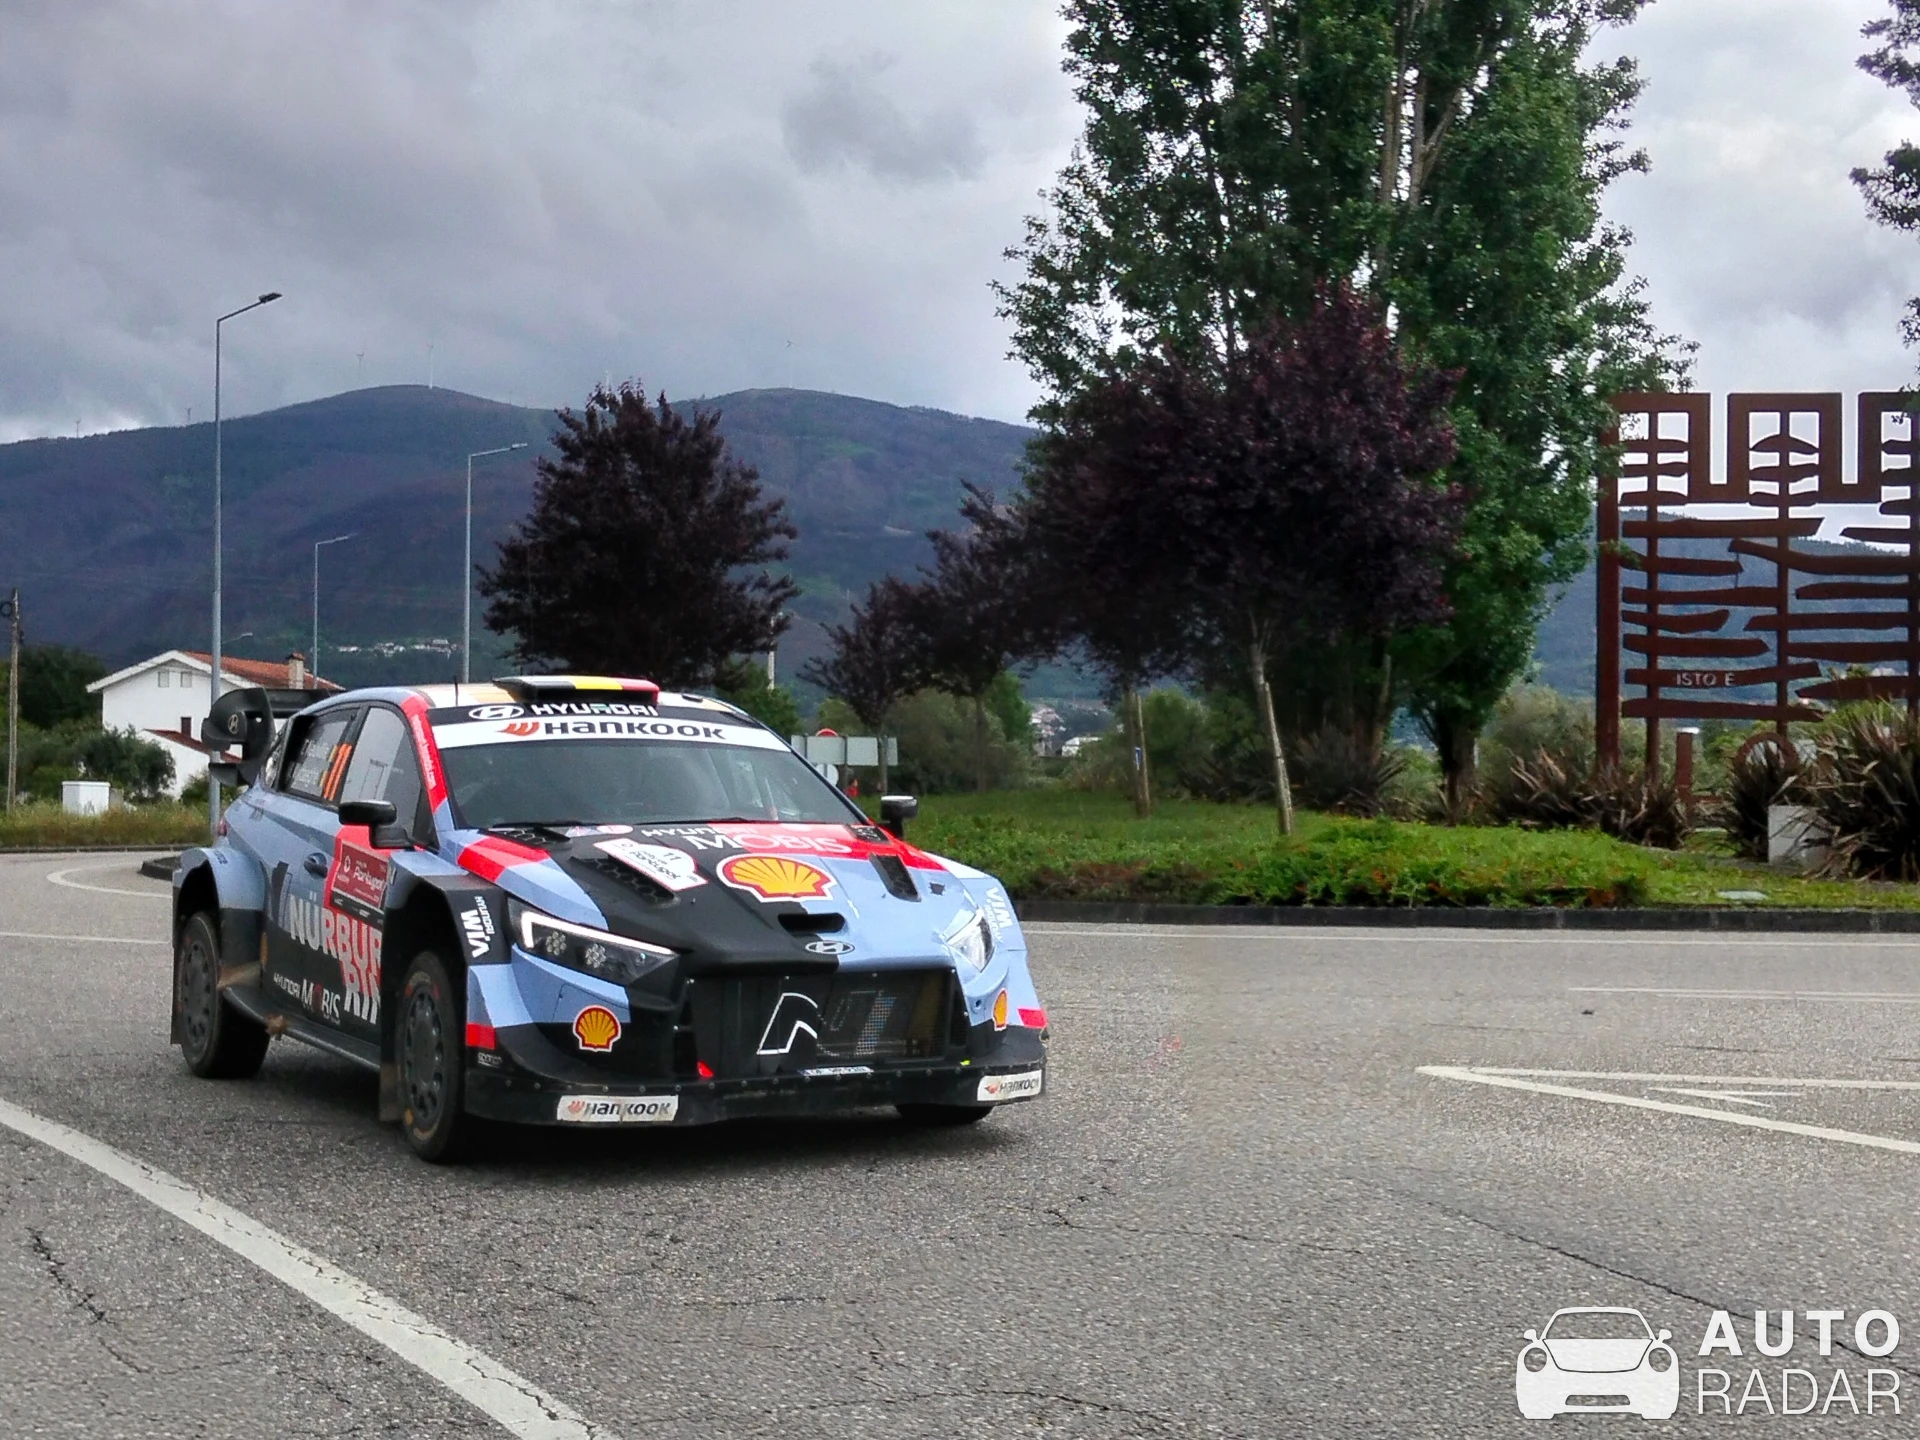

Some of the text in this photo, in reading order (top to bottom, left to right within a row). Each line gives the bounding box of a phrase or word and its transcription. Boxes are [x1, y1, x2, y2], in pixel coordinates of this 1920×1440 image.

[1676, 672, 1717, 686] ISTO
[531, 703, 659, 716] HYUNDAI
[683, 834, 852, 854] MOBIS
[474, 896, 495, 934] HYUNDAI
